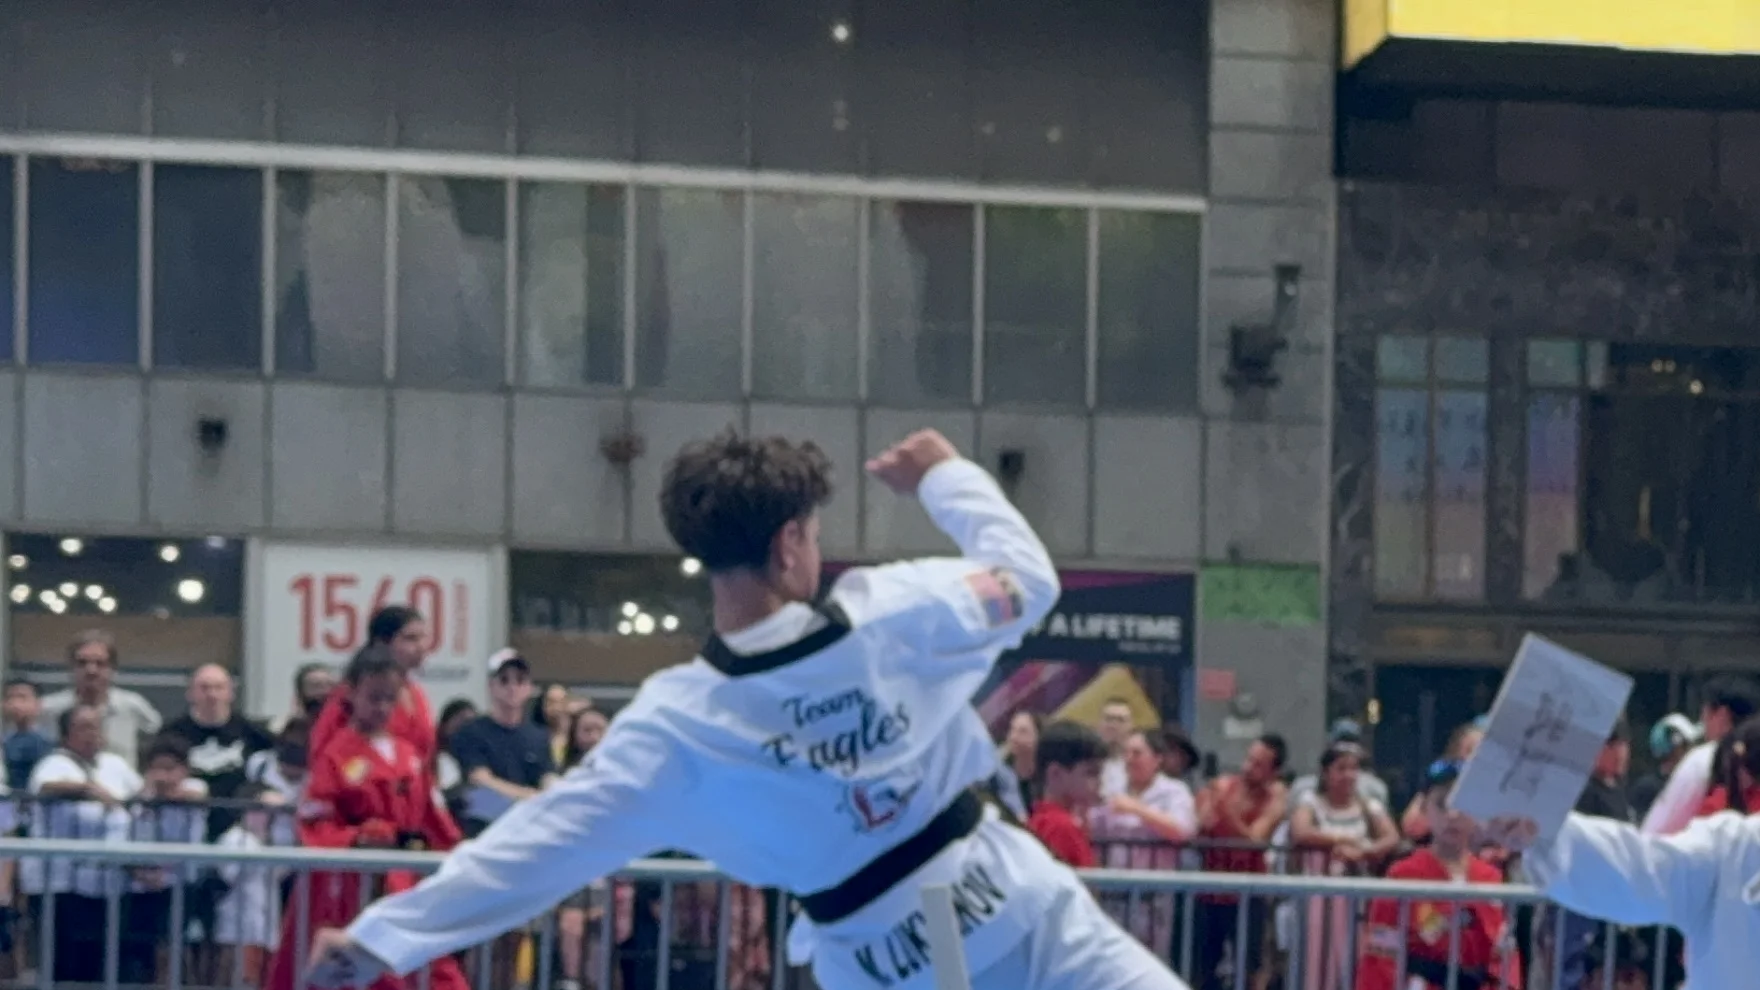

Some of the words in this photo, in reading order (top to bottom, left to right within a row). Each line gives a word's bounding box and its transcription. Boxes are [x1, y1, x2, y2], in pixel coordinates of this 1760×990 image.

[1048, 612, 1069, 637] A
[1071, 613, 1182, 641] LIFETIME
[782, 686, 864, 728] Team
